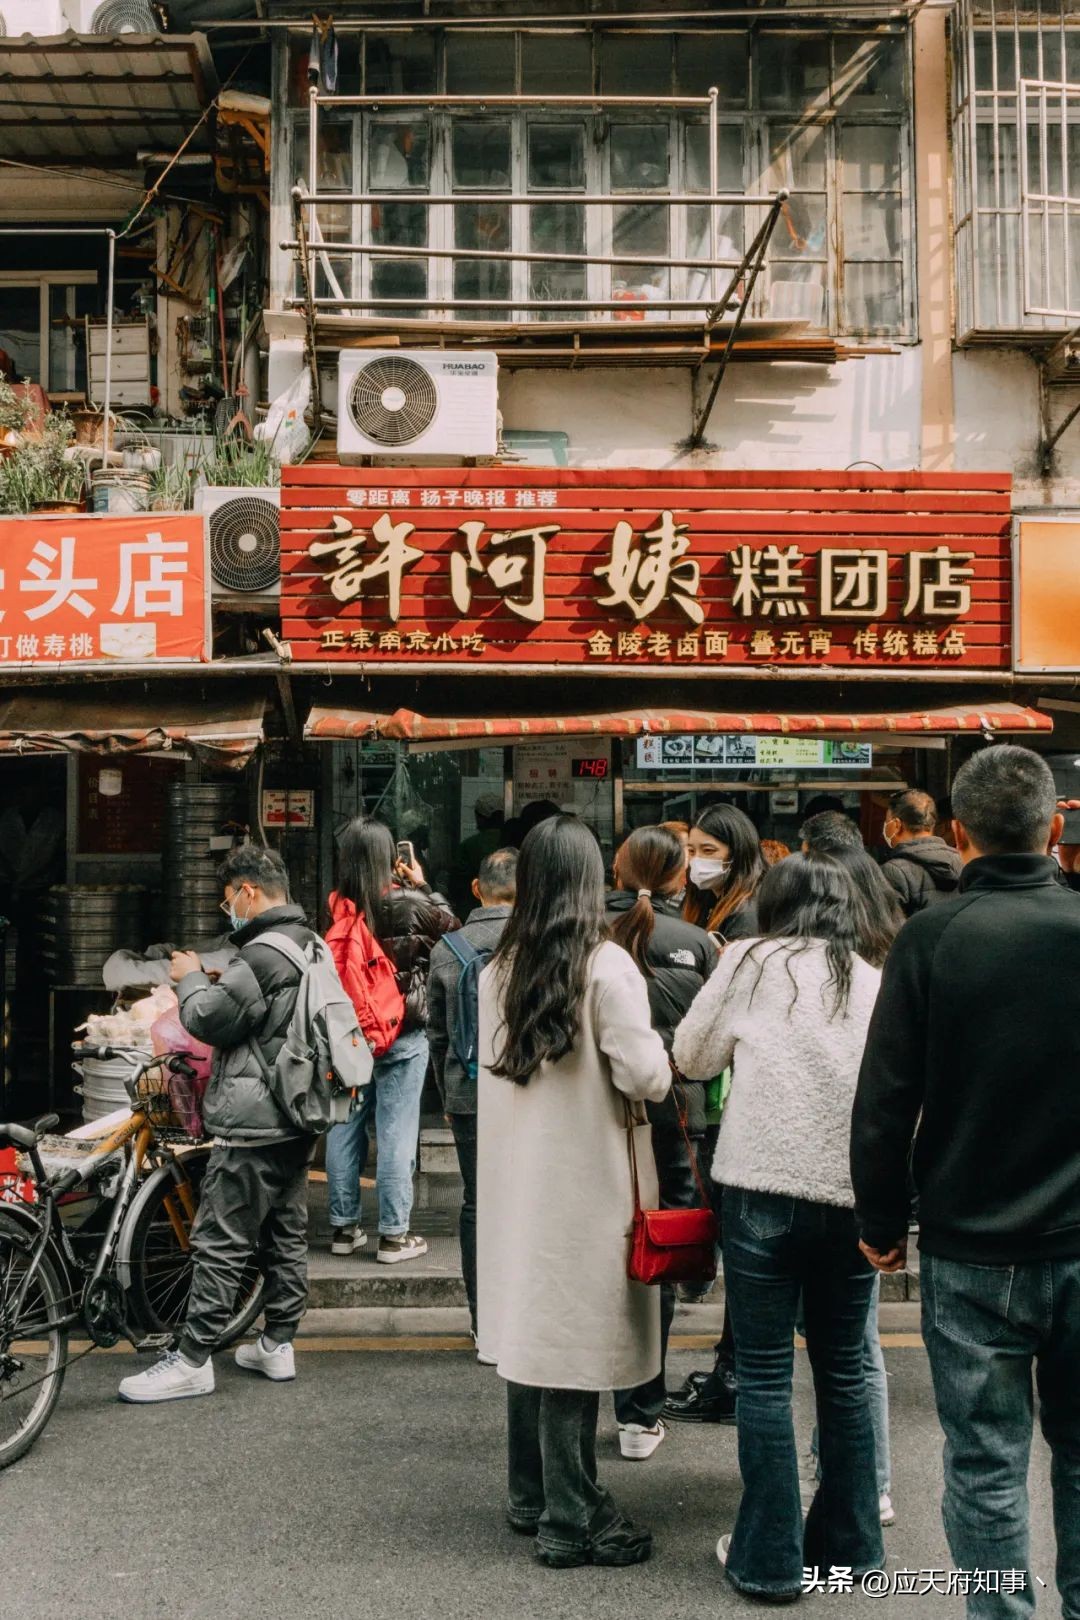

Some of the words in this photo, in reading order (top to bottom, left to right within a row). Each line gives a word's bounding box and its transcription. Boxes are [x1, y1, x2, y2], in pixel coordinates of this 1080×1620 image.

[346, 489, 411, 506] 零距离
[420, 489, 506, 506] 扬子晚报
[515, 490, 558, 506] 推荐
[0, 533, 189, 622] 头店
[728, 545, 976, 618] 糕团店
[321, 629, 487, 652] 正宗南京小吃
[588, 630, 729, 657] 金陵老卤面
[750, 629, 833, 656] 叠元宵
[852, 629, 968, 656] 传统糕点
[579, 759, 607, 777] 148
